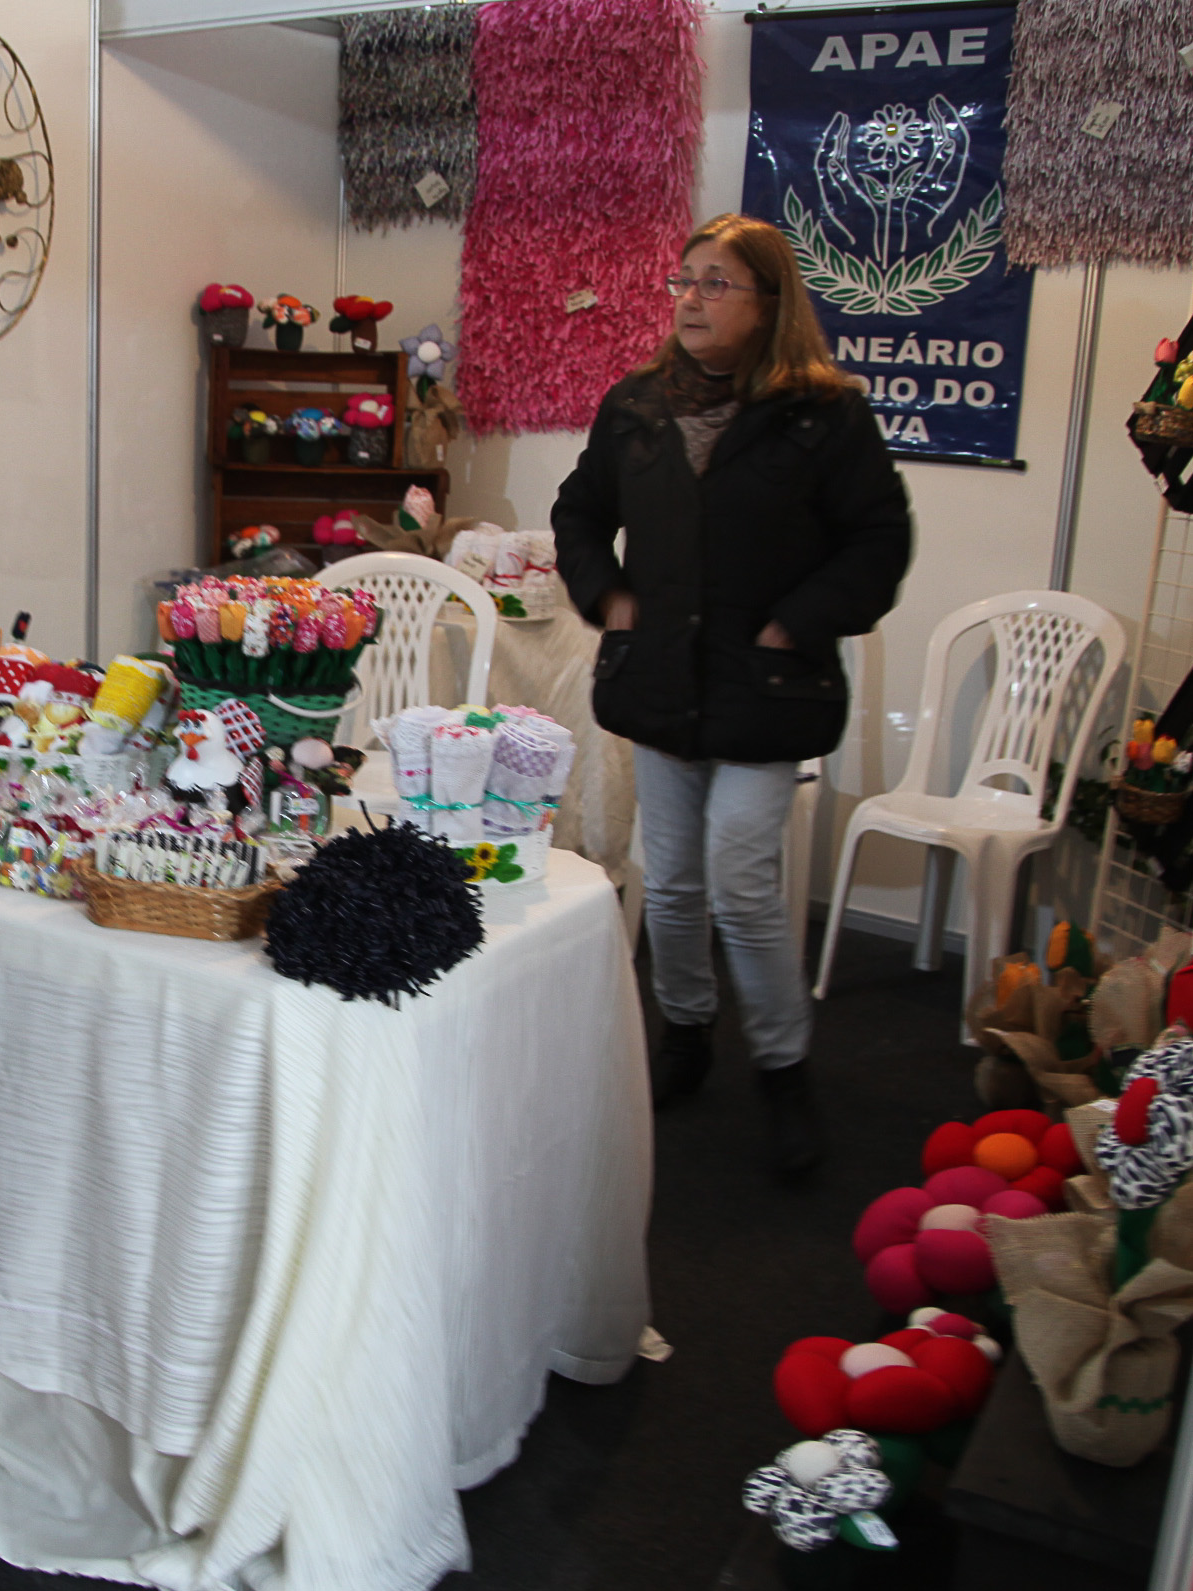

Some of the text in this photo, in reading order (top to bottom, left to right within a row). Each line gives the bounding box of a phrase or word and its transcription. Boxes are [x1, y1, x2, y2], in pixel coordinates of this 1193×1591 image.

[809, 27, 988, 72] APAE
[829, 331, 1004, 368] NEÁRIO
[933, 378, 995, 407] DO
[874, 413, 930, 442] VA
